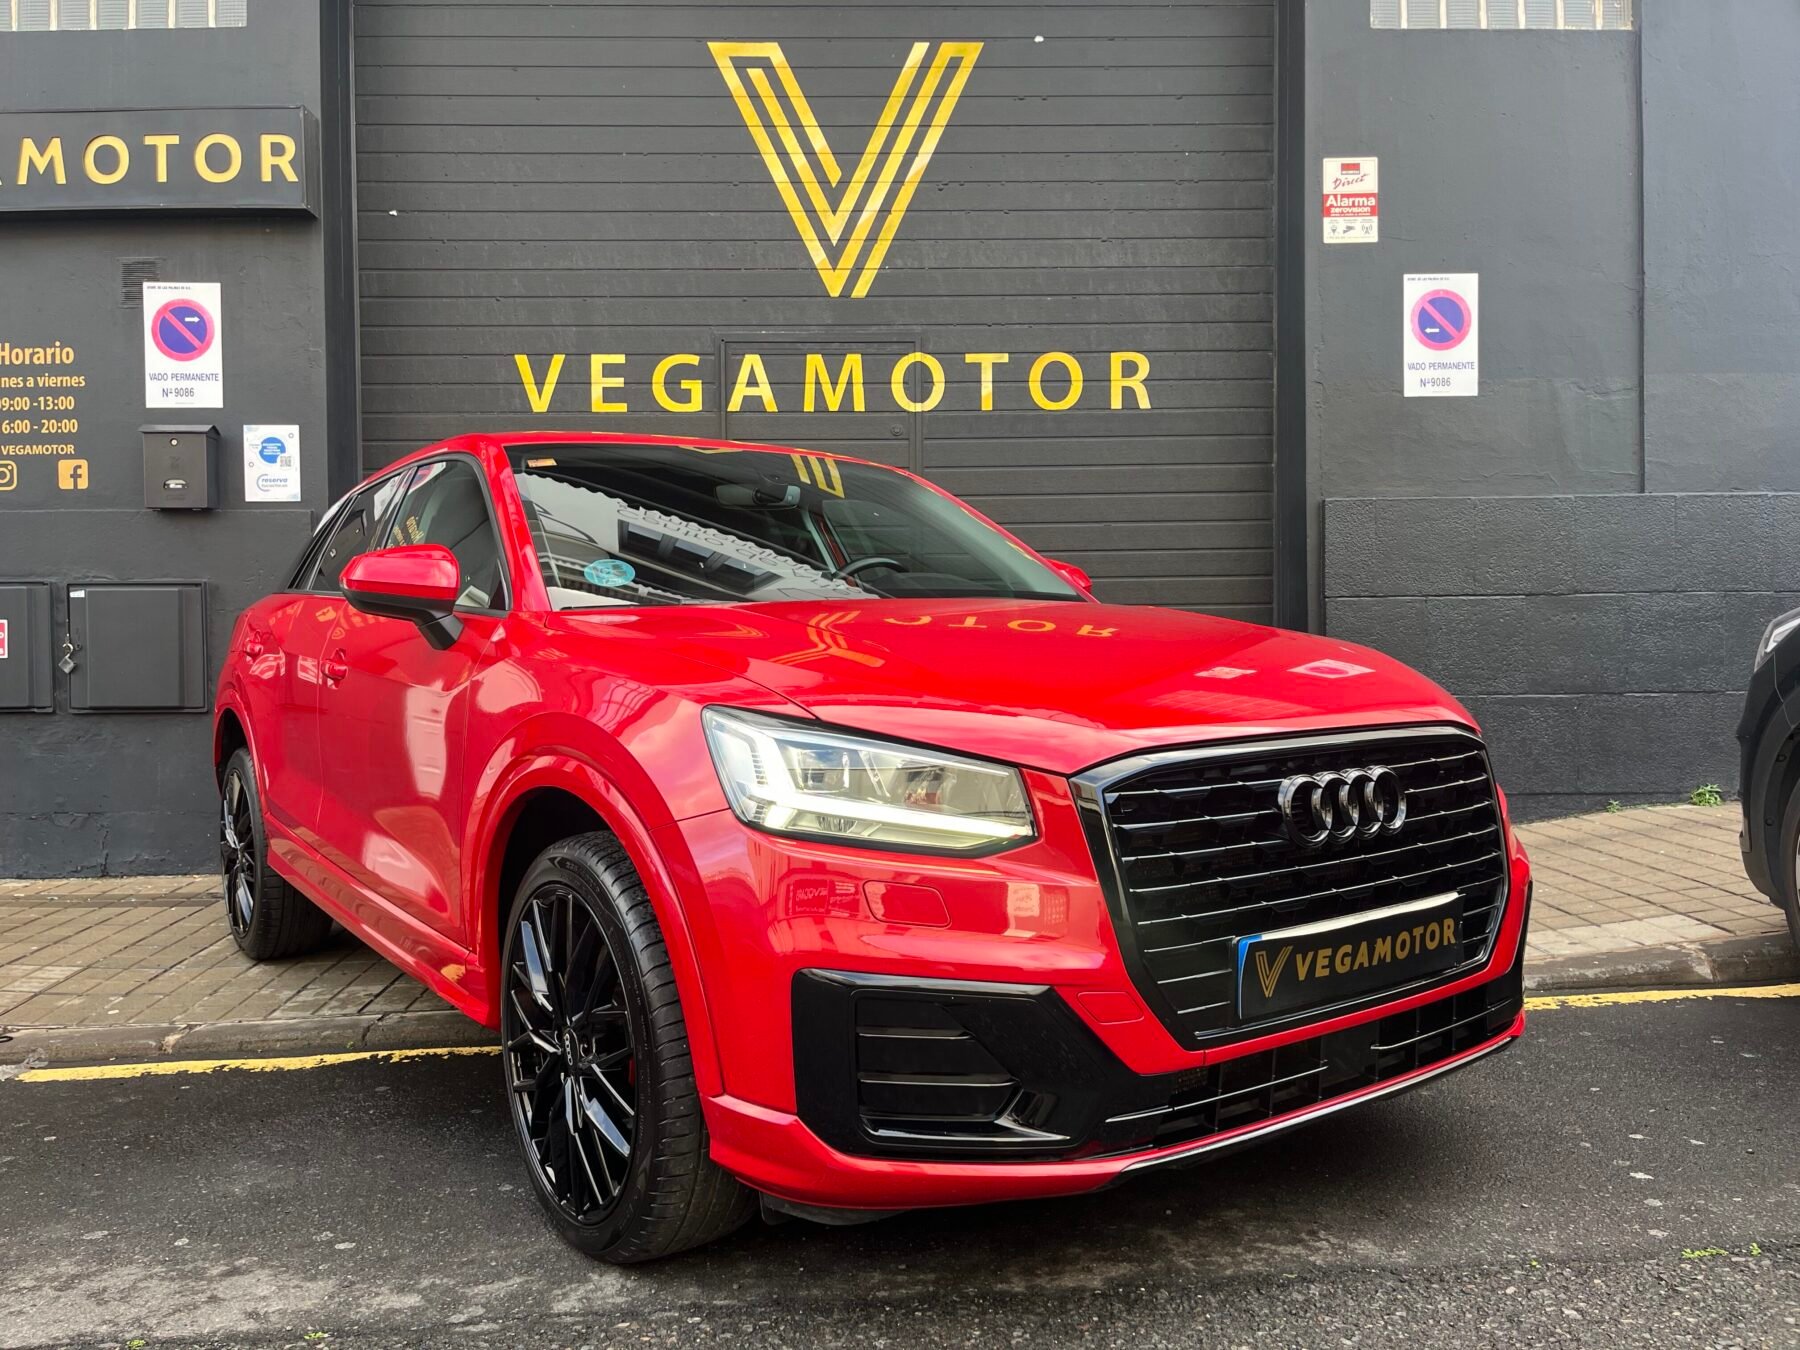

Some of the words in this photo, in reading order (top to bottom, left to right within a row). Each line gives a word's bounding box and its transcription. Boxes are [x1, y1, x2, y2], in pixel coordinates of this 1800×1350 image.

[0, 133, 299, 185] MOTOR
[1326, 194, 1376, 207] Alarma
[0, 341, 75, 365] Horario
[1408, 362, 1426, 370] VADO
[1429, 361, 1475, 370] PERMANENTE
[26, 376, 35, 387] a
[37, 373, 86, 387] viernes
[149, 373, 168, 381] VADO
[171, 373, 220, 382] PERMANENTE
[514, 351, 1151, 413] VEGAMOTOR
[0, 397, 30, 411] 9:00
[41, 419, 78, 433] 20:00
[1, 445, 75, 455] VEGAMOTOR
[1295, 918, 1457, 981] VEGAMOTOR
